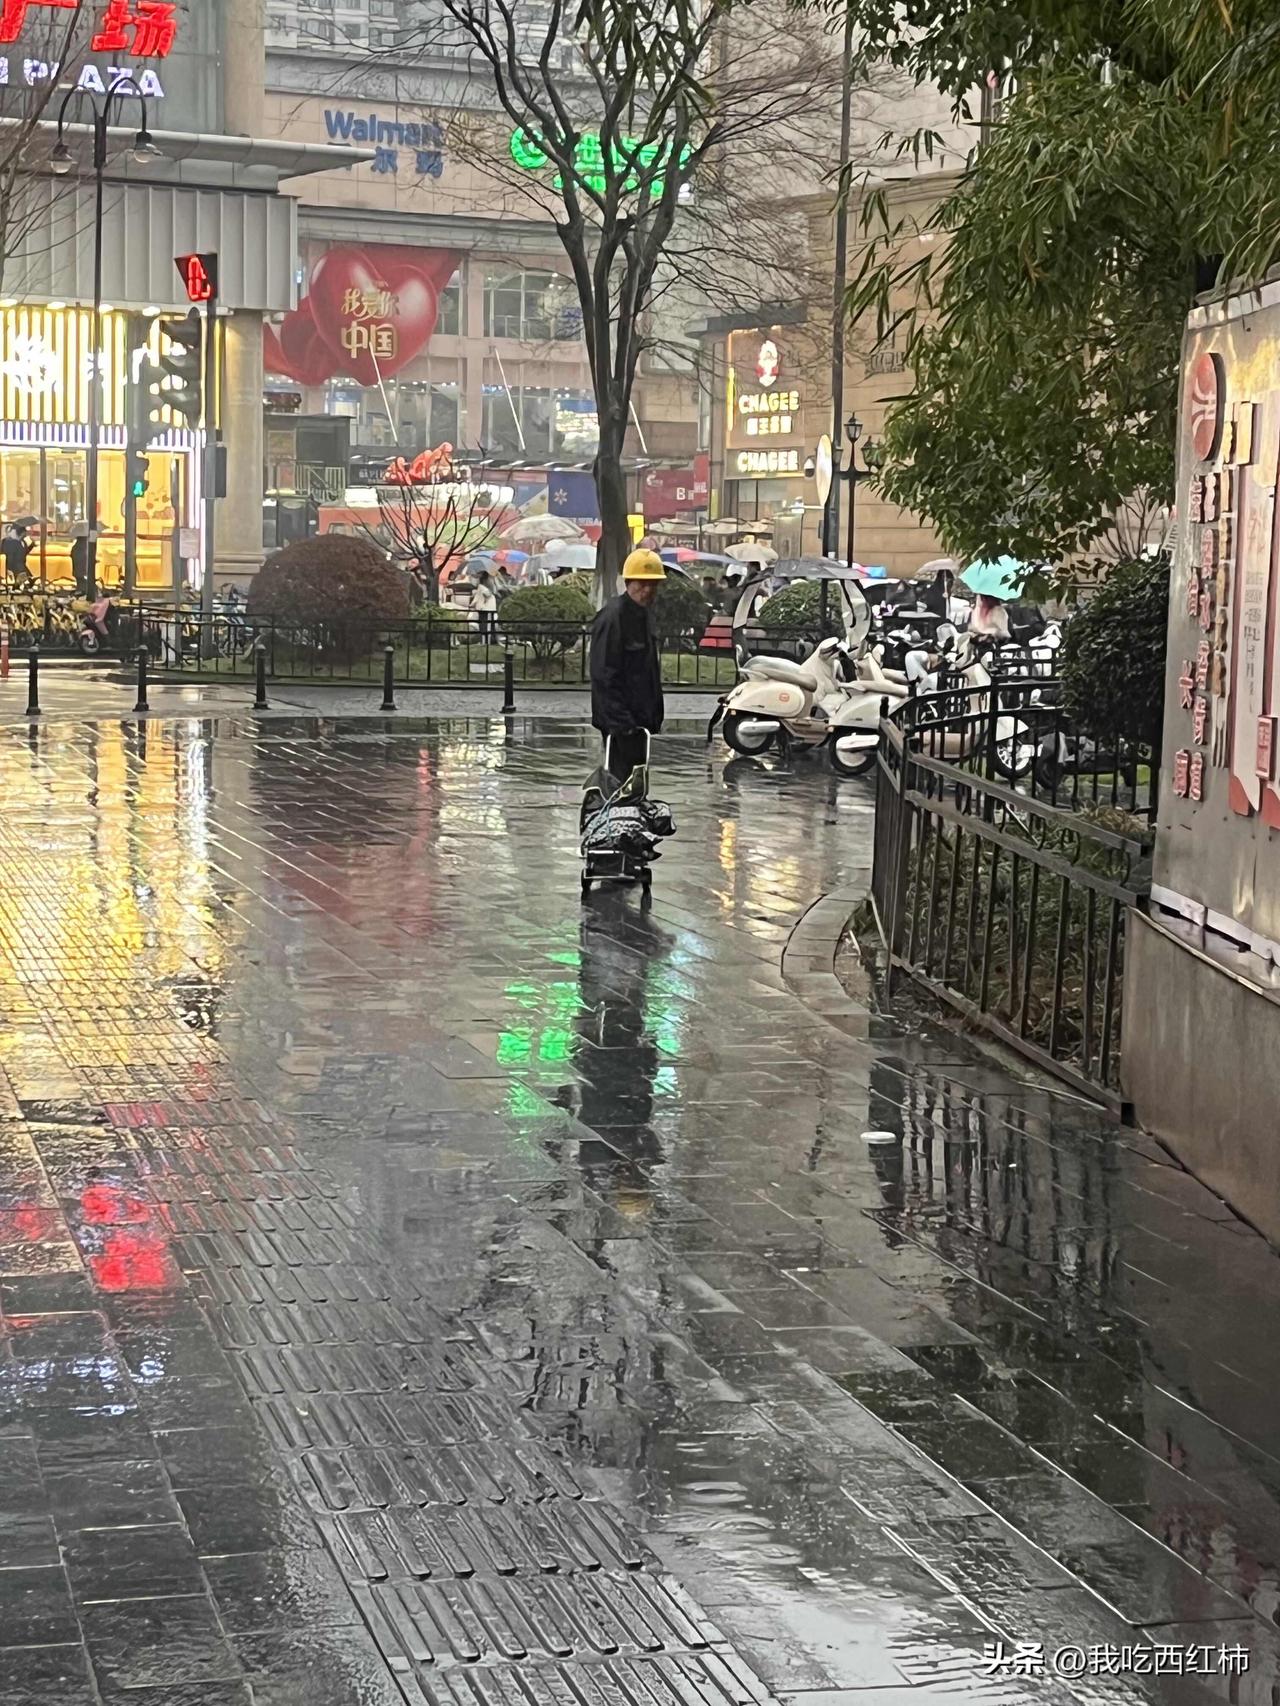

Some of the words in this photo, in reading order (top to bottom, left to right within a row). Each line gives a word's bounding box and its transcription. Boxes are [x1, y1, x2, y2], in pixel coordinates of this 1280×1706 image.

[325, 110, 443, 147] Walmart
[341, 321, 399, 360] 中国
[738, 390, 800, 414] CHAGEE
[737, 450, 799, 473] CHAGEE
